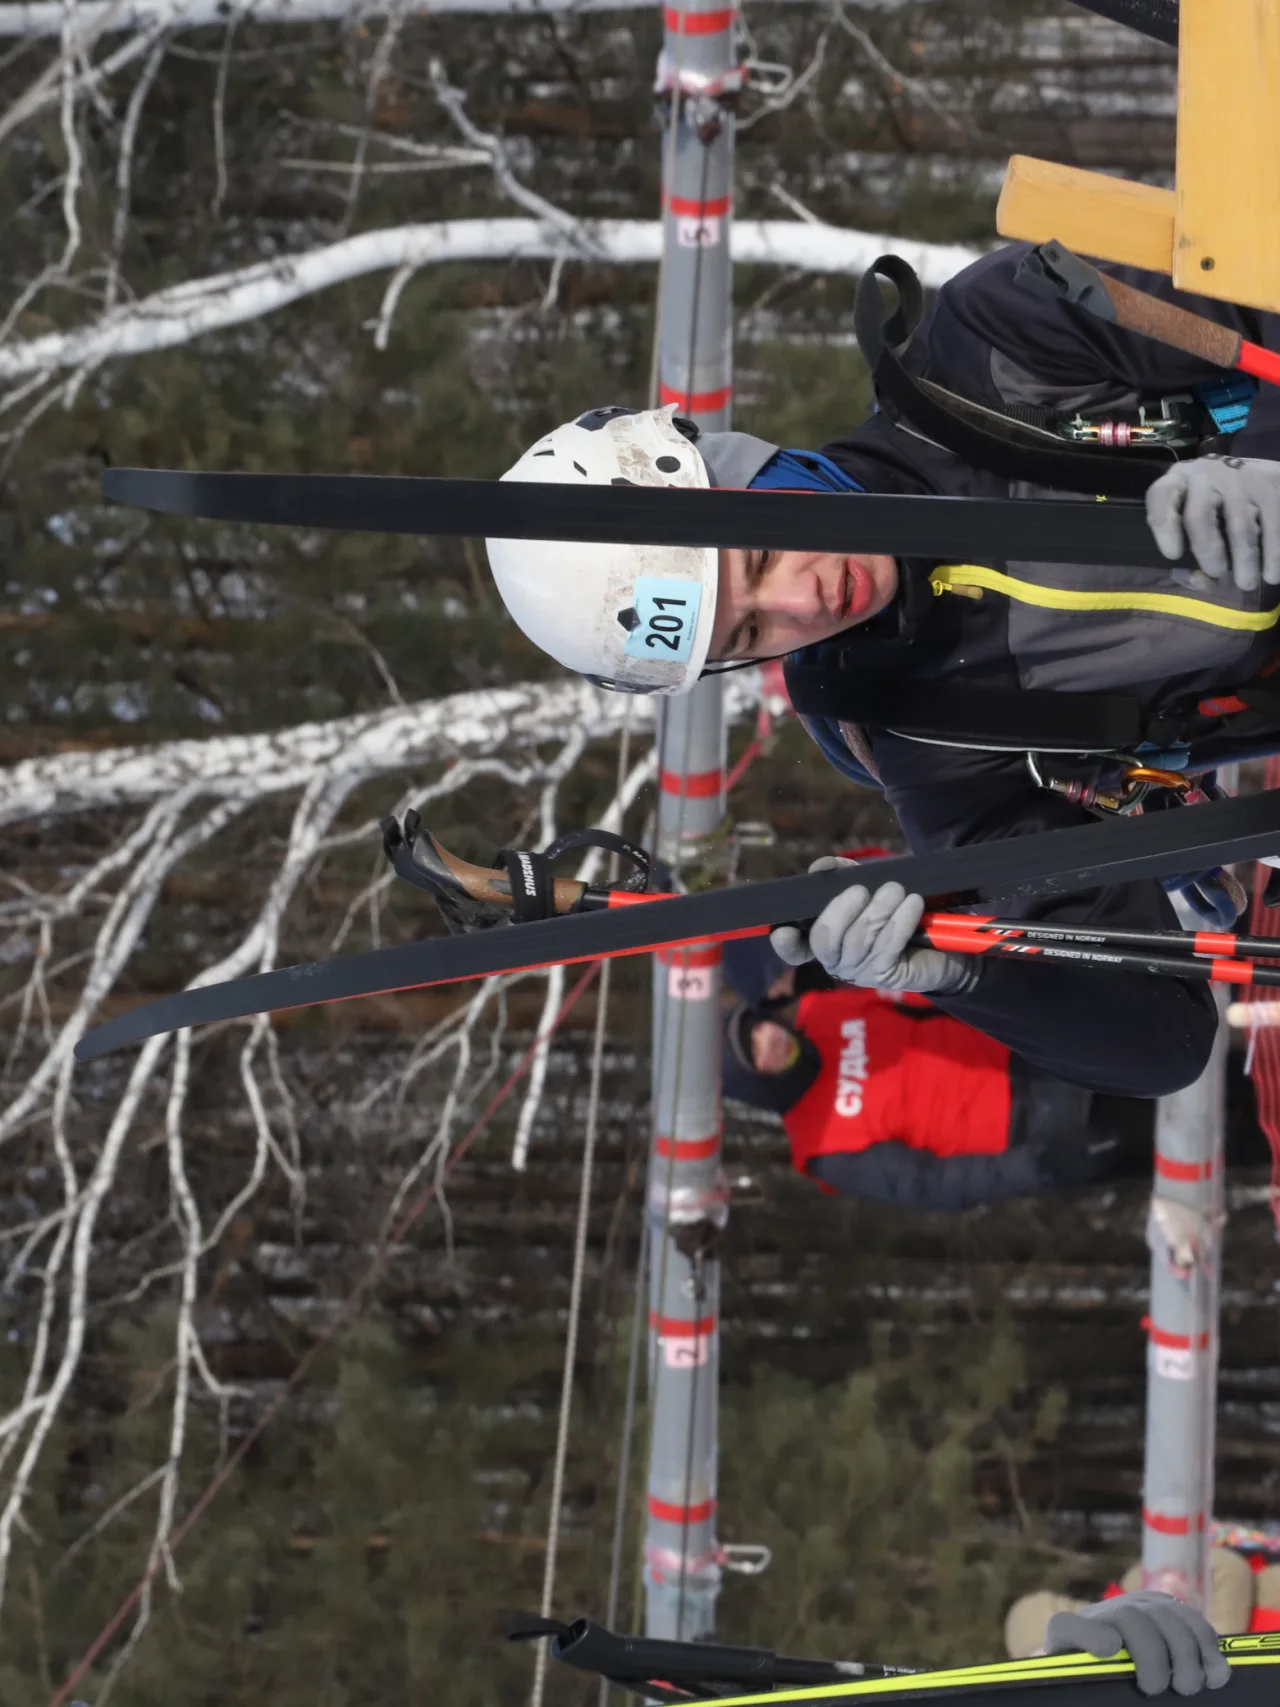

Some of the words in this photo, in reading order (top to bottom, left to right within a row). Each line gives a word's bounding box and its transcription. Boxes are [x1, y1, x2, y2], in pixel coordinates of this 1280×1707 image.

[645, 597, 686, 651] 201
[1027, 931, 1064, 940] DESIGNED
[1074, 935, 1106, 943] NORWAY
[1043, 948, 1081, 959] DESIGNED
[1081, 952, 1091, 960] IN
[1091, 953, 1123, 963] NORWAY
[835, 1018, 869, 1117] СУДЬЯ
